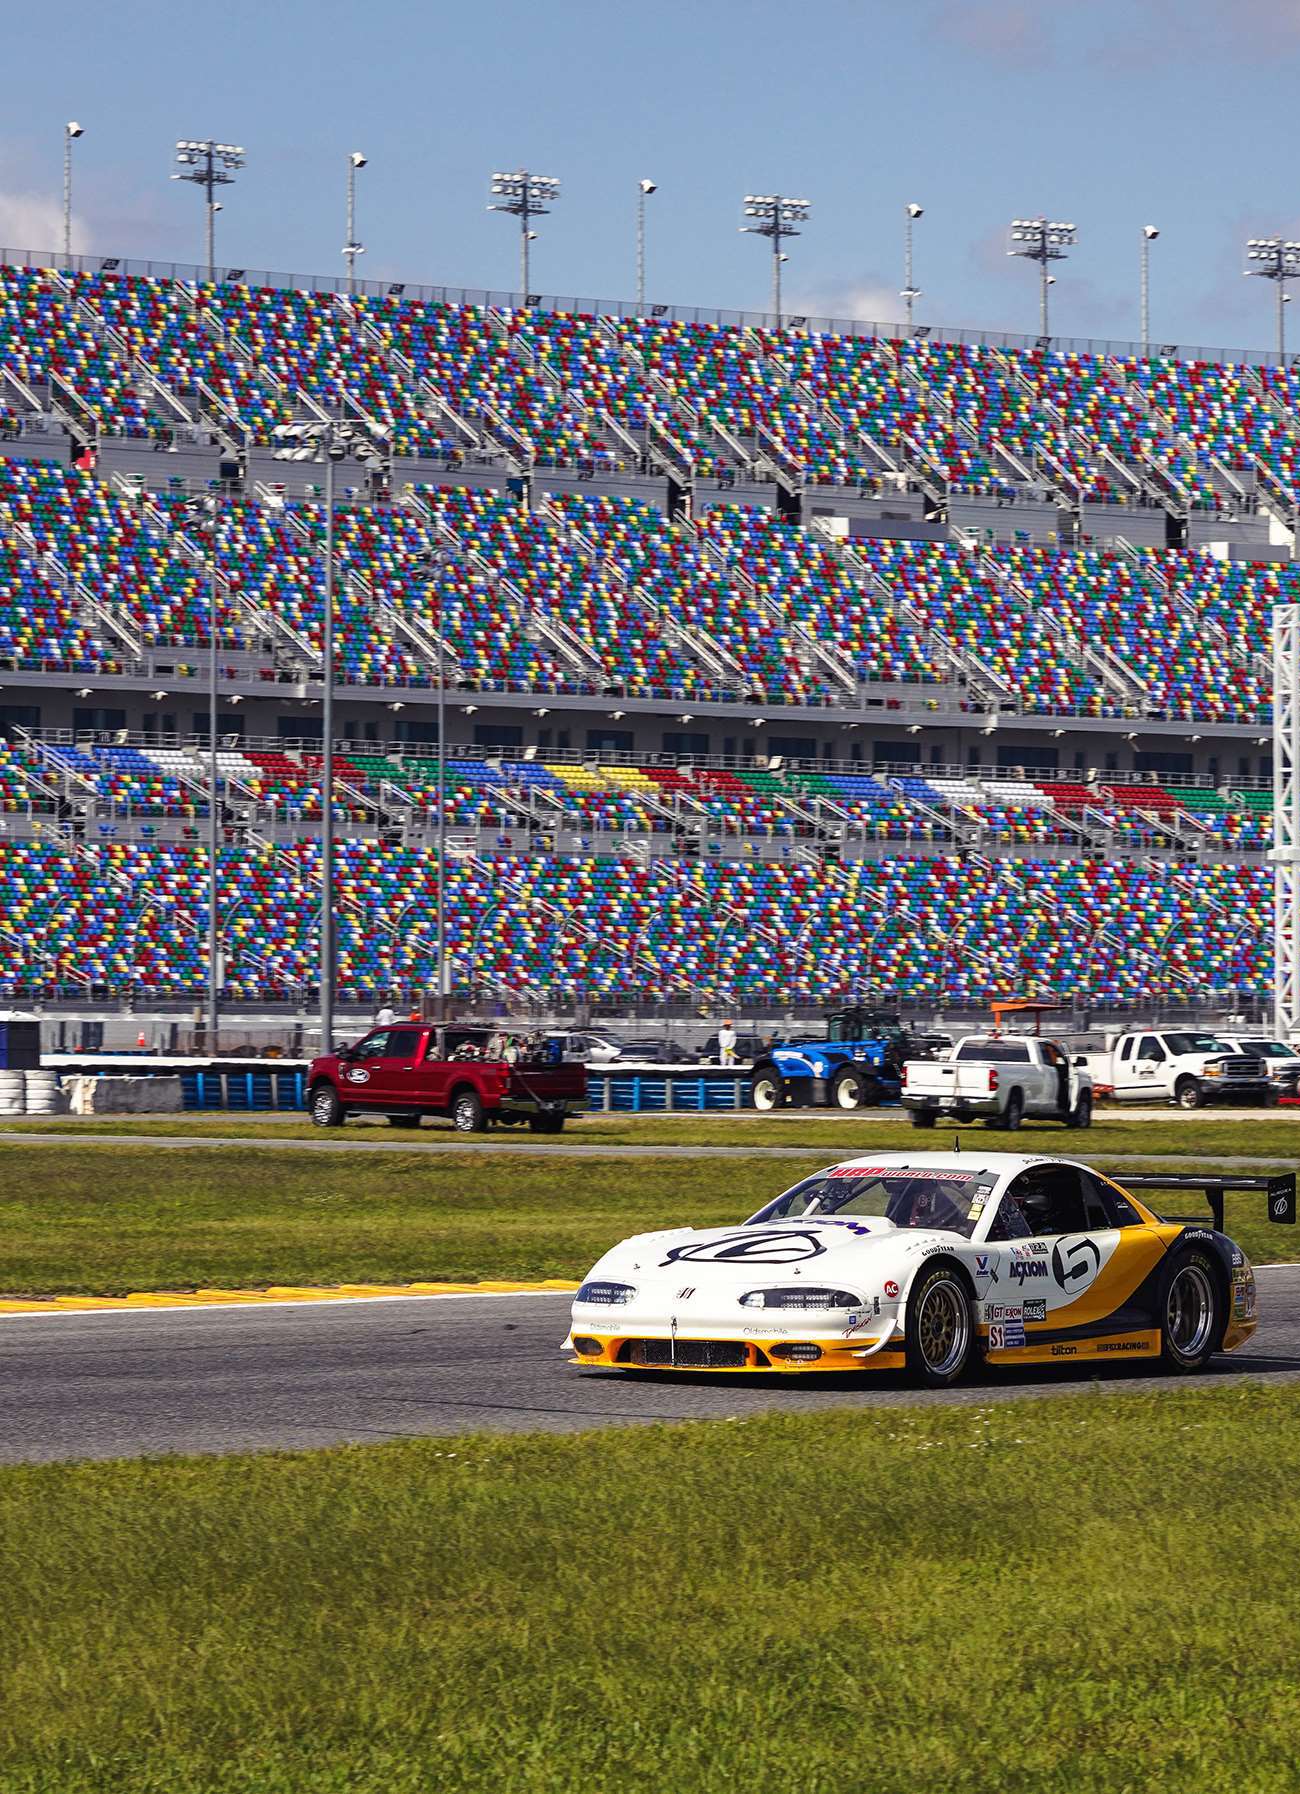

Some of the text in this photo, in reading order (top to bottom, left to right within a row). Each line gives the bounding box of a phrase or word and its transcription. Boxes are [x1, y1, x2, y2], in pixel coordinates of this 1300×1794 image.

[1184, 1230, 1214, 1241] GOODYEAR
[1009, 1260, 1049, 1286] ACXIOM
[885, 1284, 899, 1294] AC
[994, 1306, 1004, 1319] GT
[990, 1326, 1003, 1347] S1
[1051, 1344, 1077, 1356] tilton
